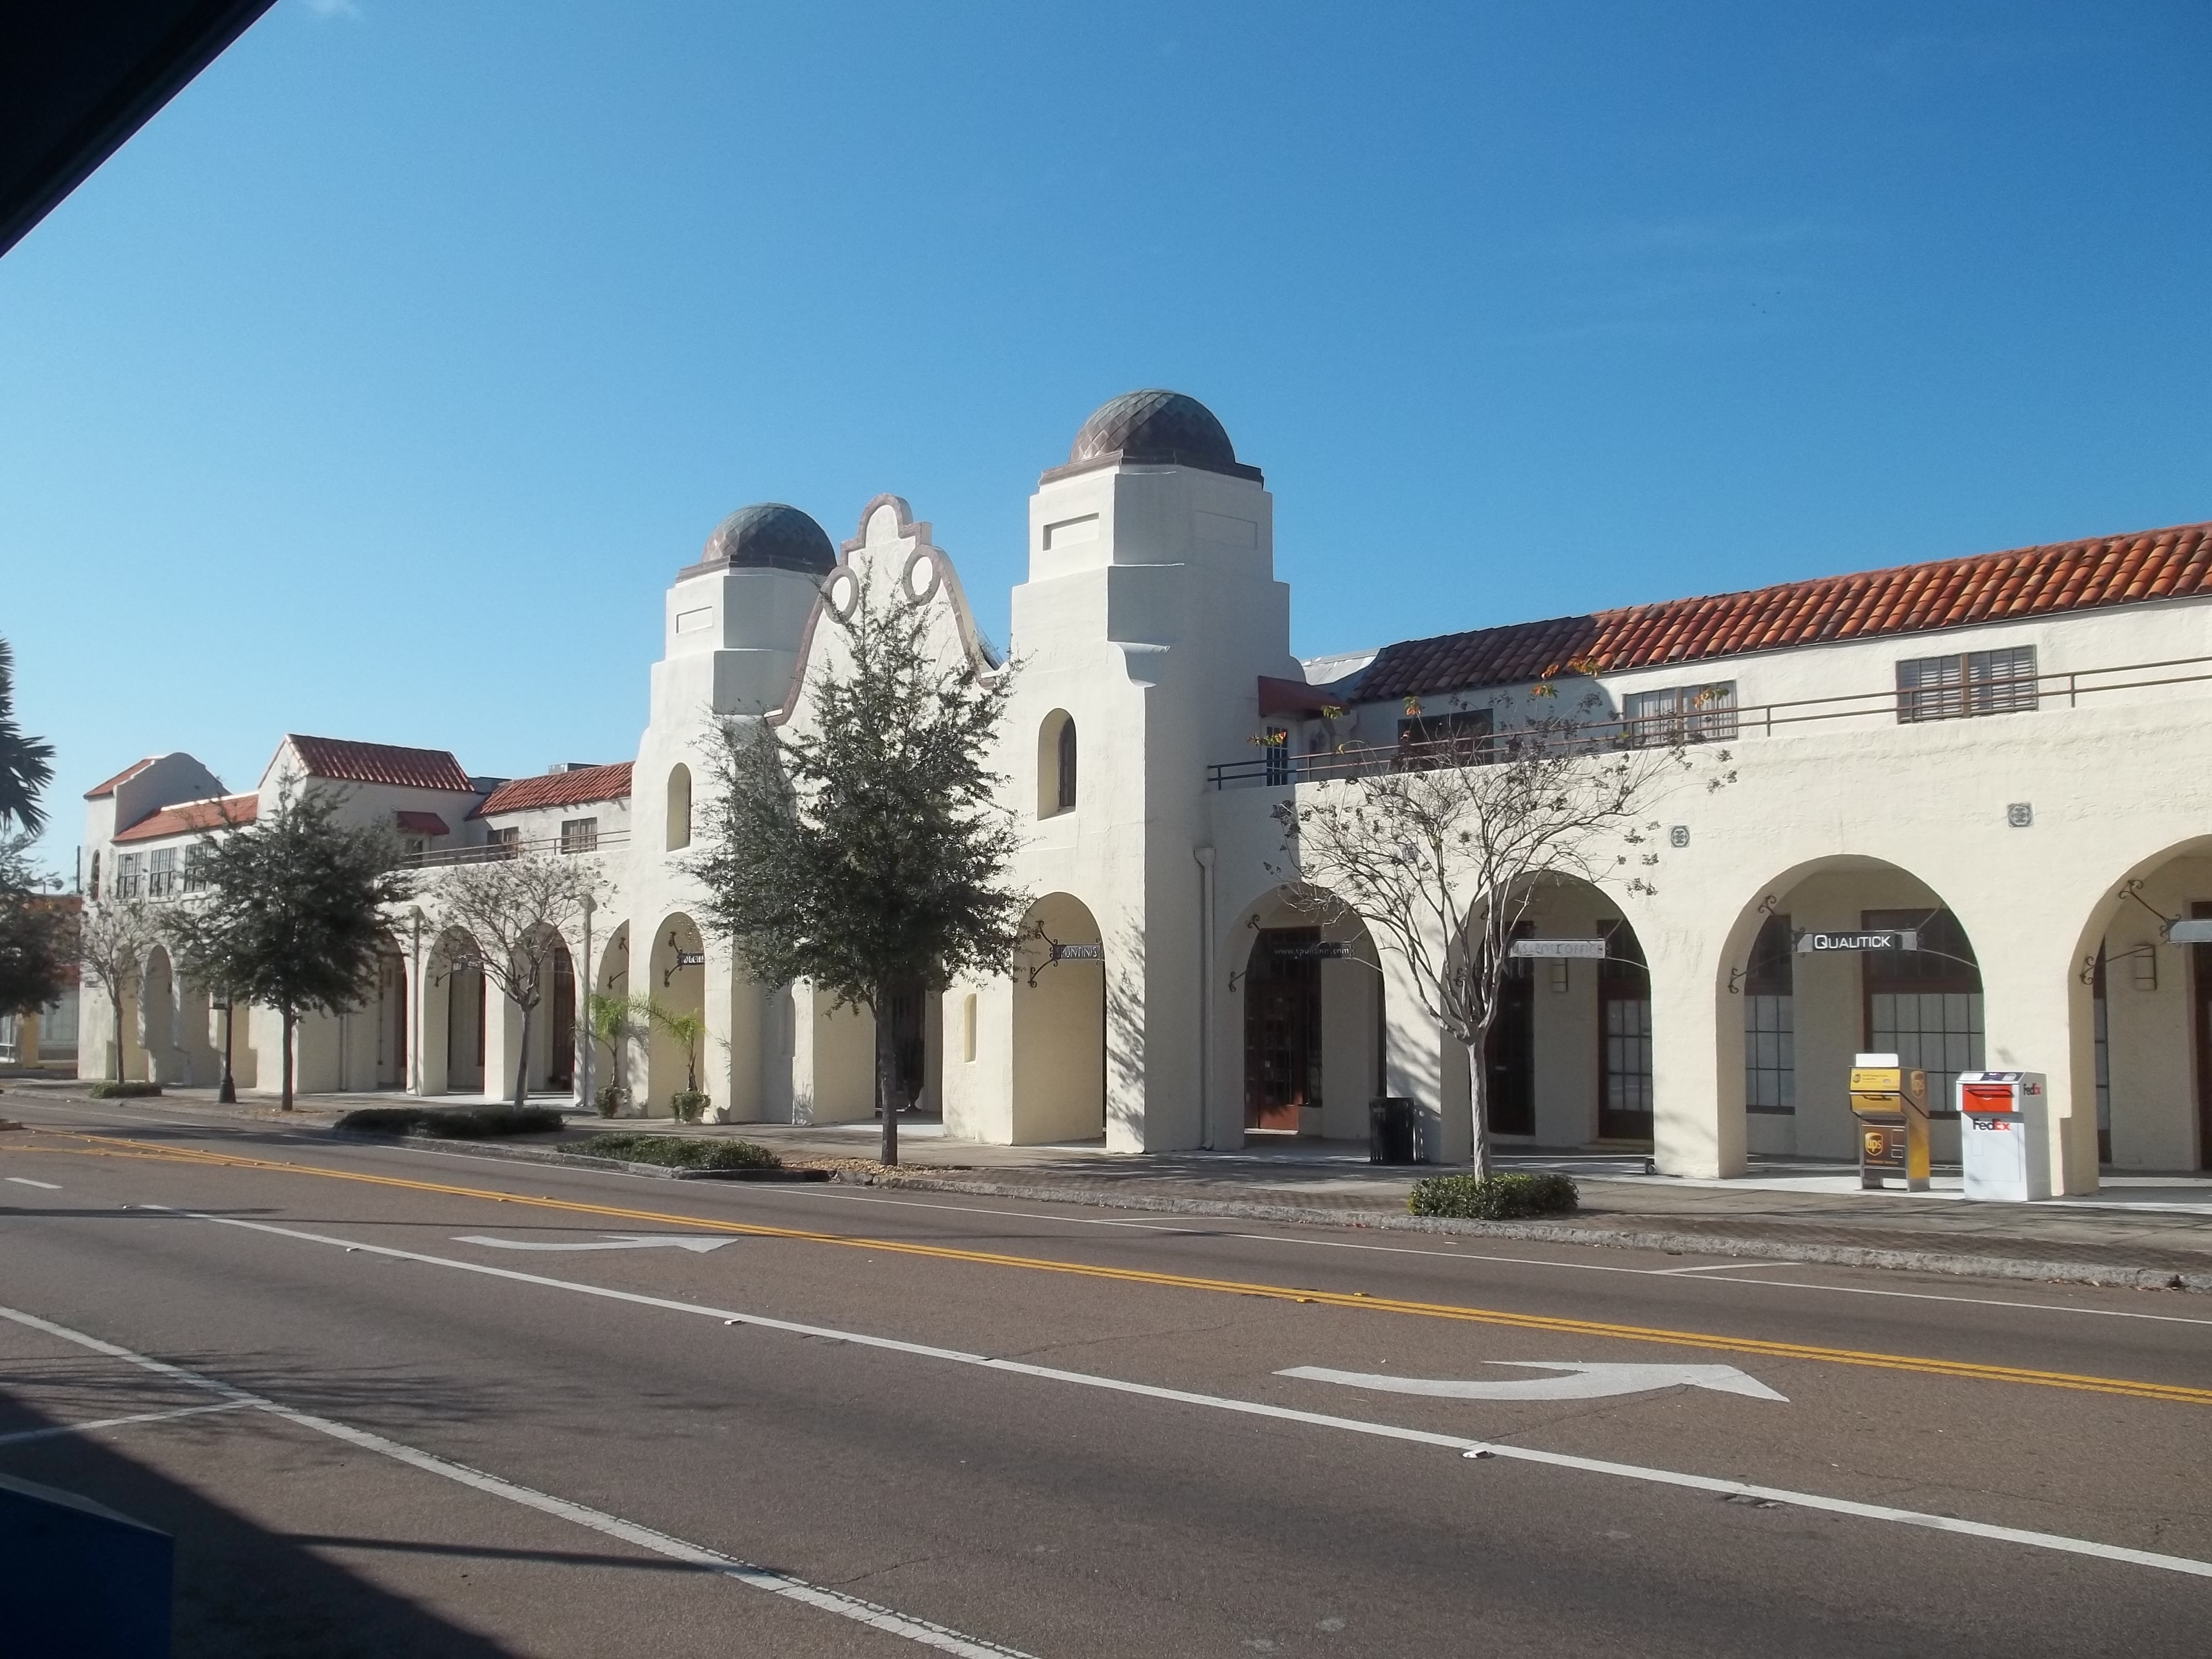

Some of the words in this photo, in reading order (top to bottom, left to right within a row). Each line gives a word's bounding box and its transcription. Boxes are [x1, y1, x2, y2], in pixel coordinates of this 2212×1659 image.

[1814, 934, 1892, 949] QUALITICK
[1274, 948, 1349, 957] www.spunnis.com
[2023, 1083, 2042, 1096] FedEx
[1973, 1118, 2010, 1131] FedEx
[1867, 1139, 1882, 1152] ups
